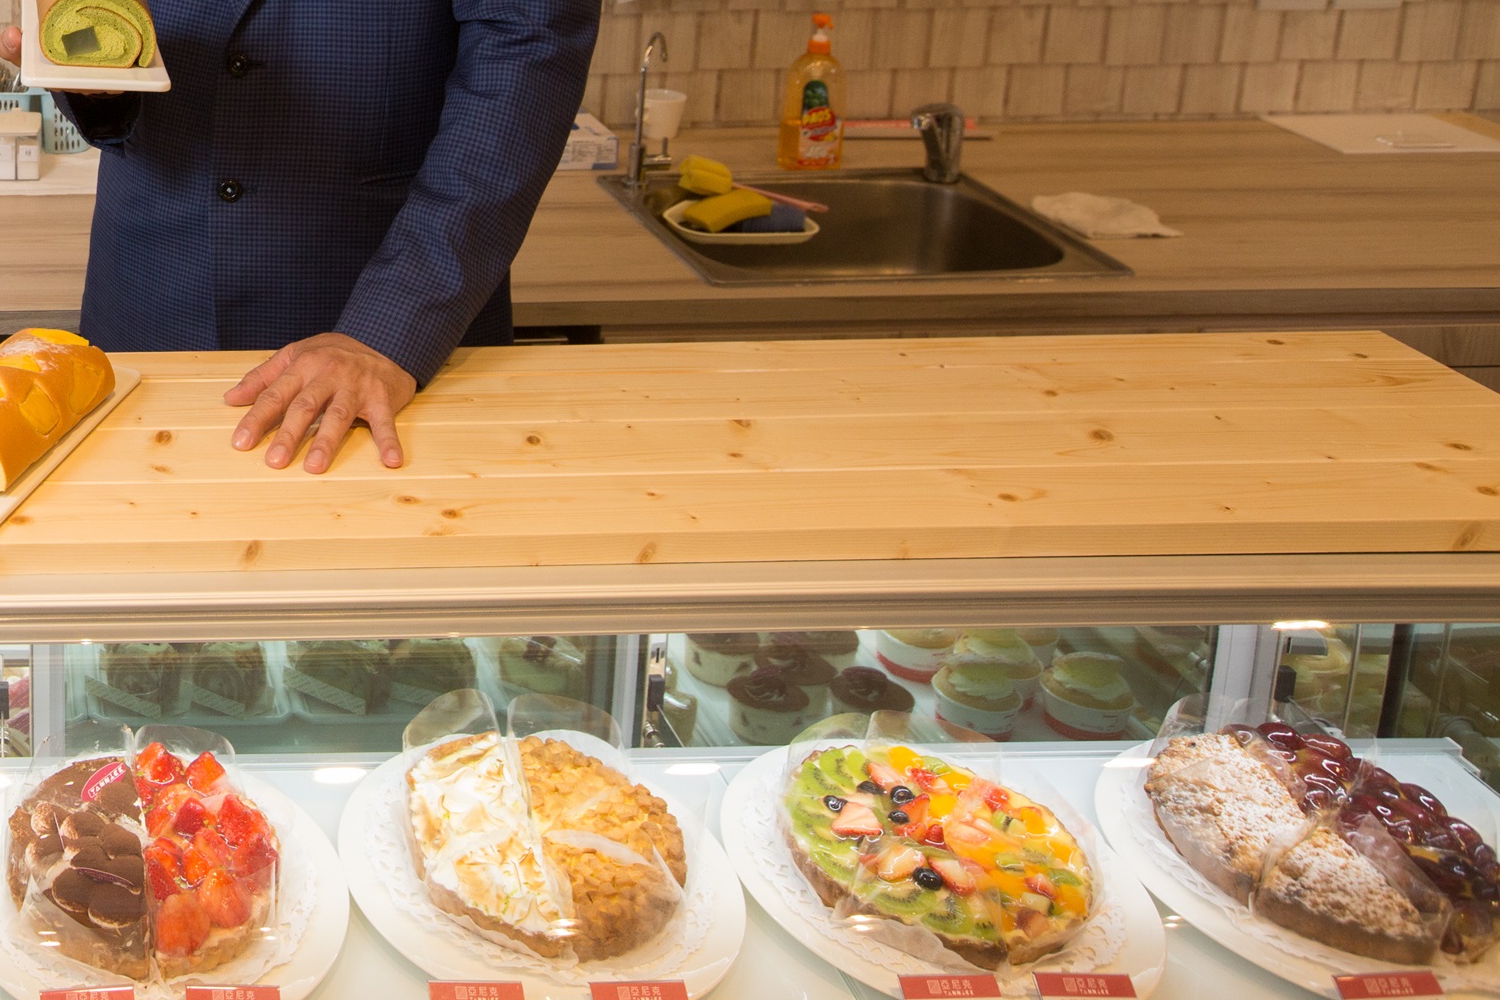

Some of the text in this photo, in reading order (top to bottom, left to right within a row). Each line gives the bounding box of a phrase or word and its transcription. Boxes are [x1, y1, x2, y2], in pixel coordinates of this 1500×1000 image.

[468, 986, 499, 997] 亞尼克
[630, 986, 662, 997] 亞尼克
